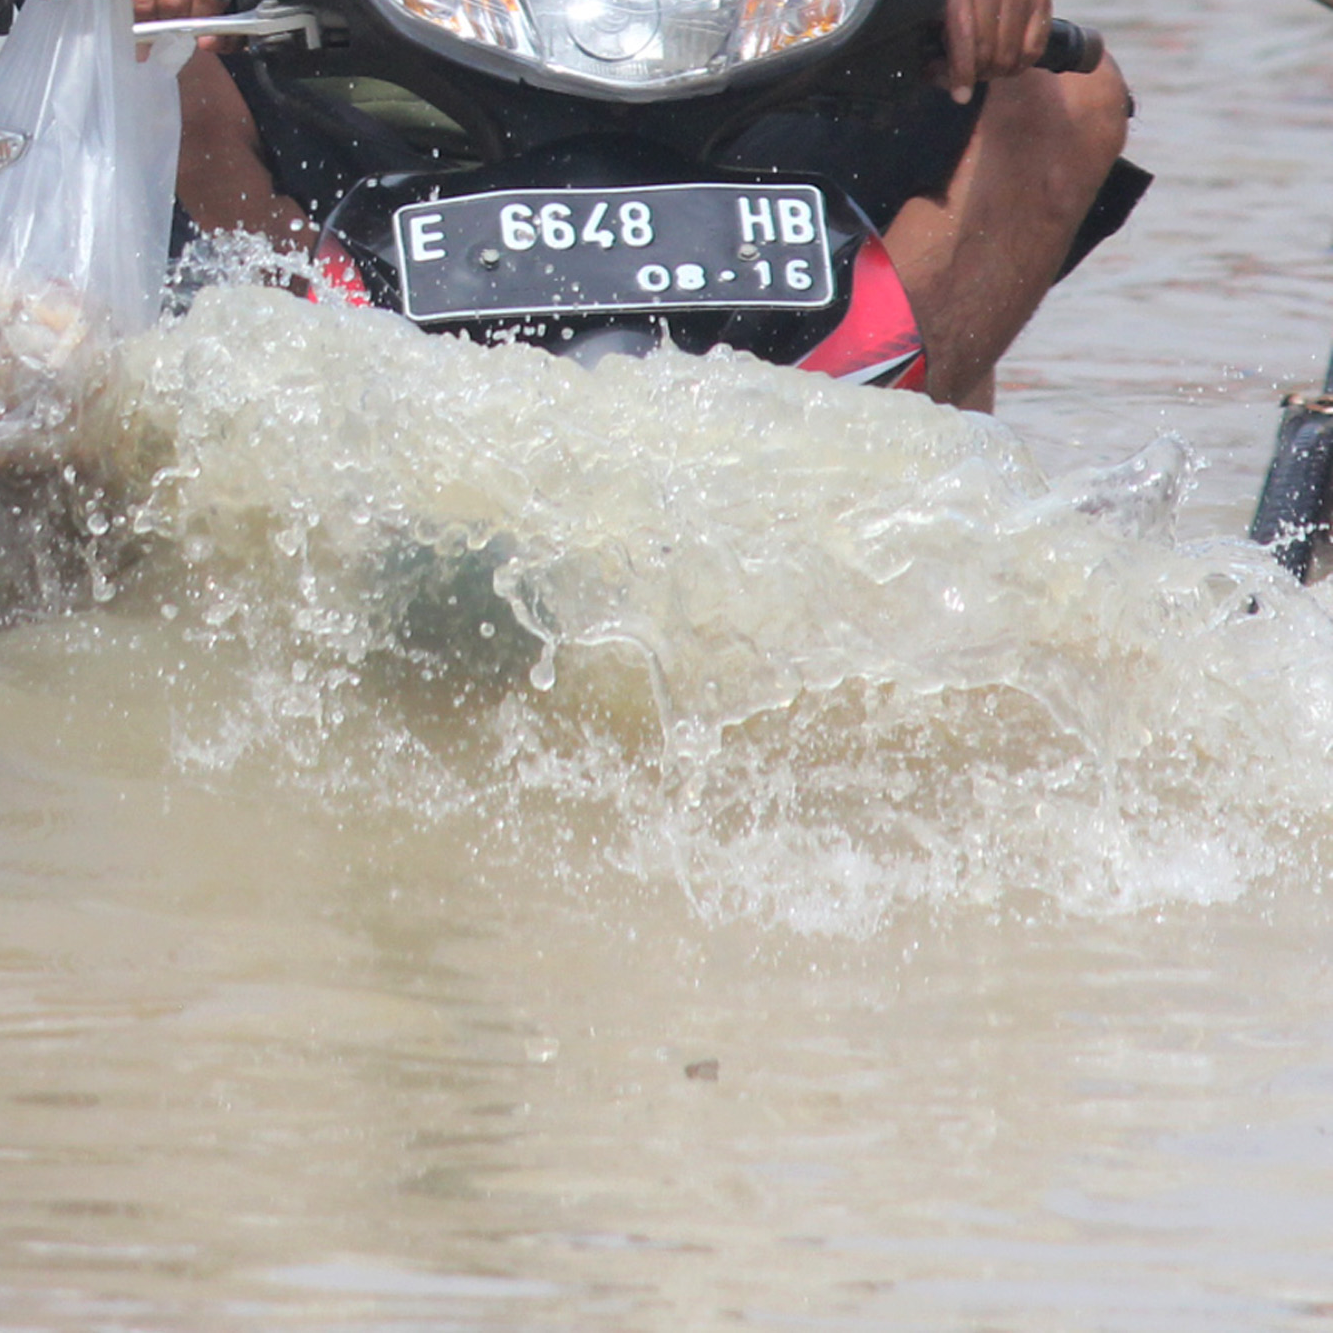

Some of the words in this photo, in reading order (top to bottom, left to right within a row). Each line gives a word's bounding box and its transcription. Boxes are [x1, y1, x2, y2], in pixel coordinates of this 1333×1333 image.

[410, 214, 445, 261] E
[500, 201, 653, 250] 6648
[738, 197, 815, 245] HB
